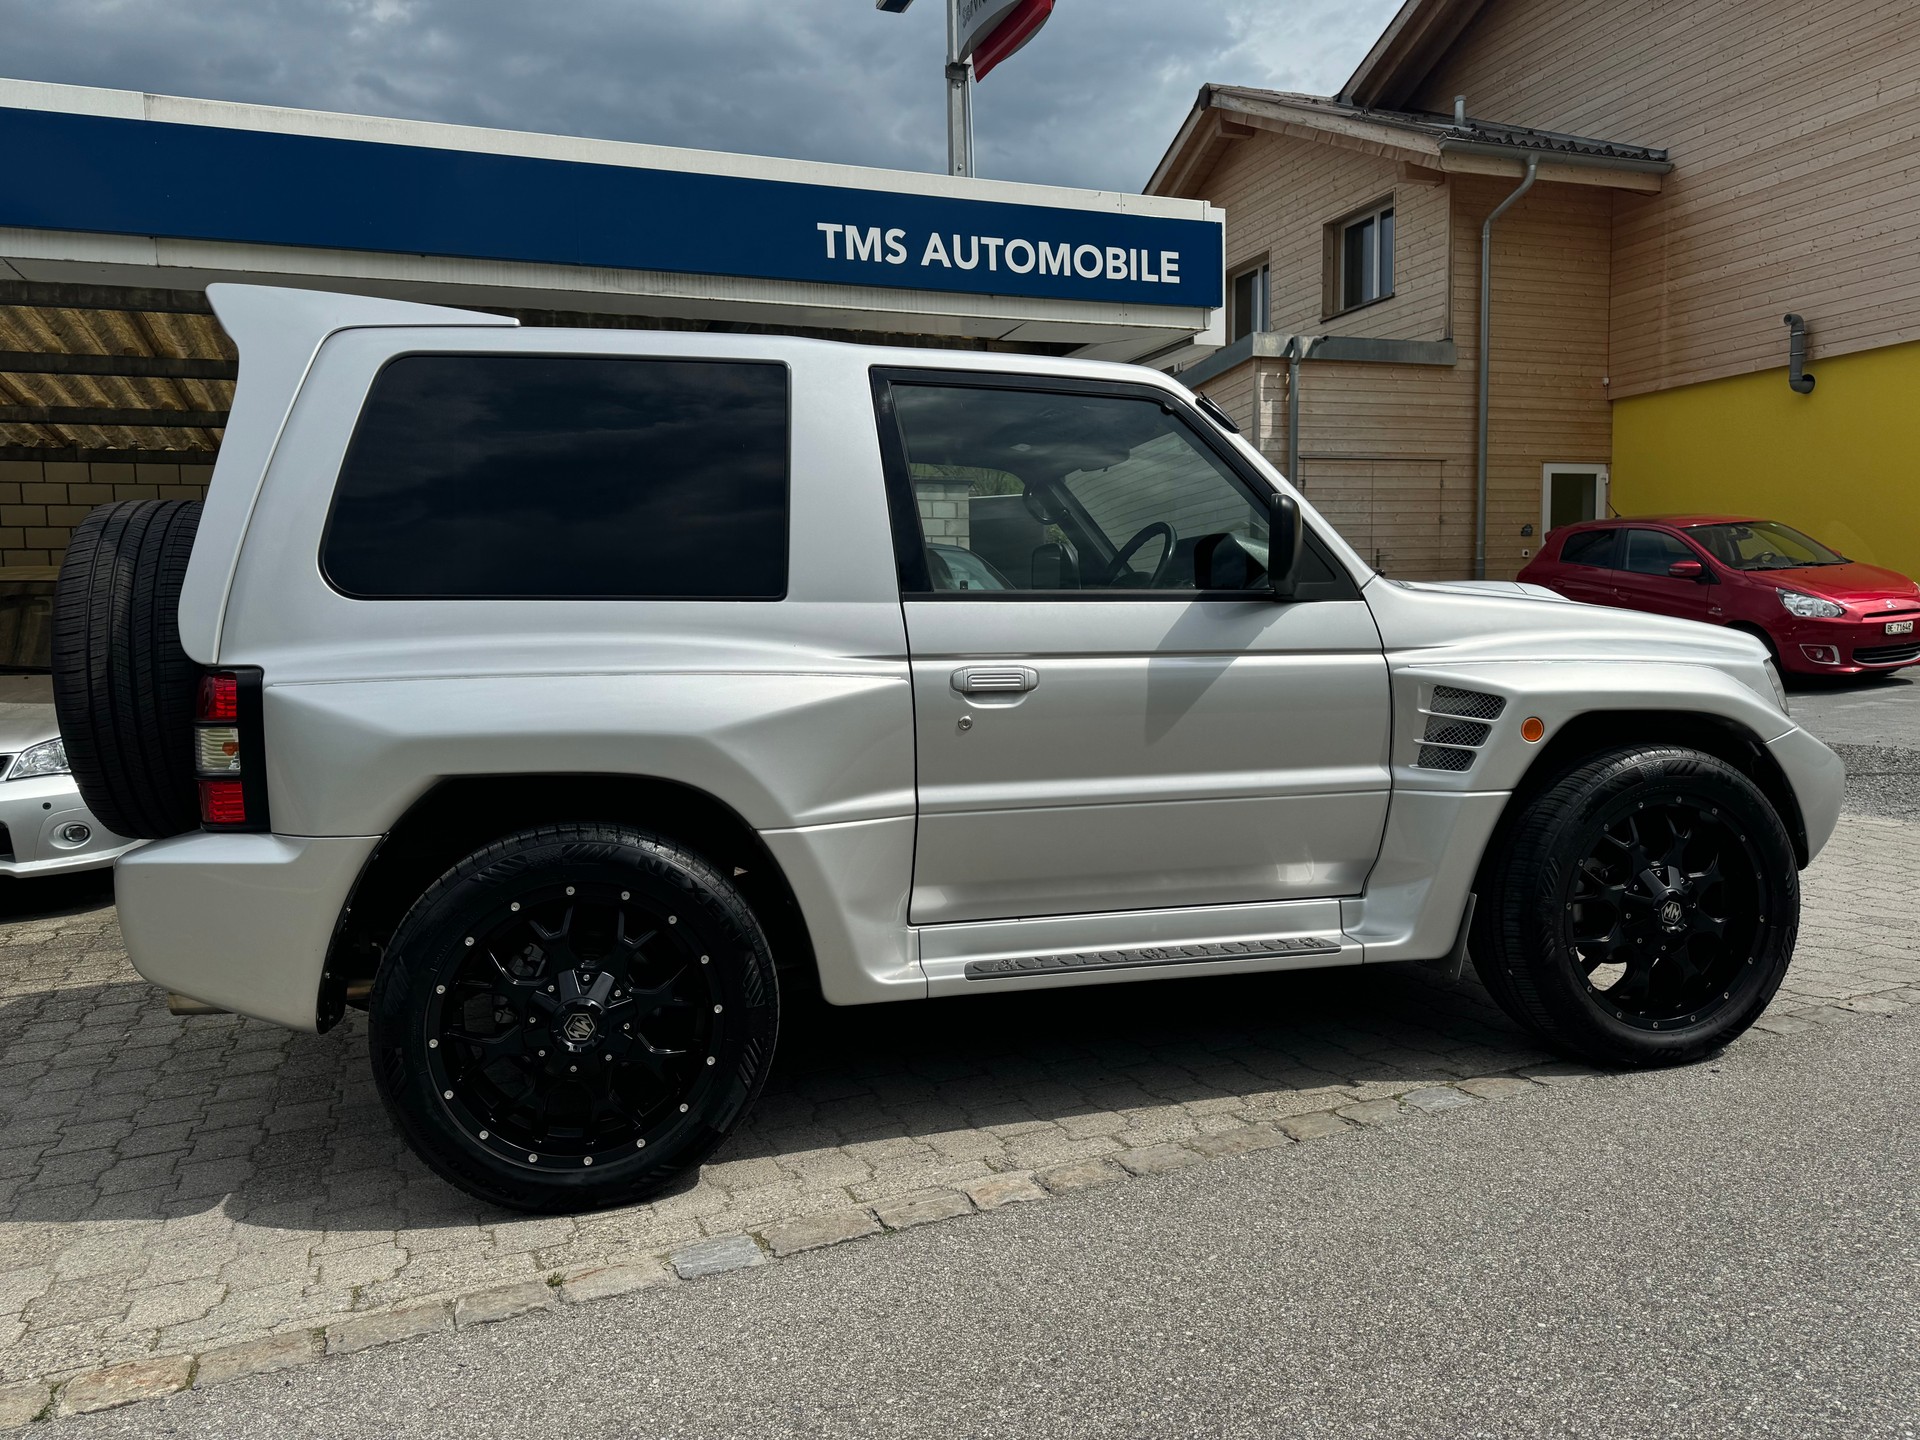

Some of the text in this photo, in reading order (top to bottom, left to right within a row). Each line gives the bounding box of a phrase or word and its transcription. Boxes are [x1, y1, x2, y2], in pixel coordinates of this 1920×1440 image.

[816, 222, 1181, 284] TMS AUTOMOBILE
[635, 854, 744, 944] NEXEN
